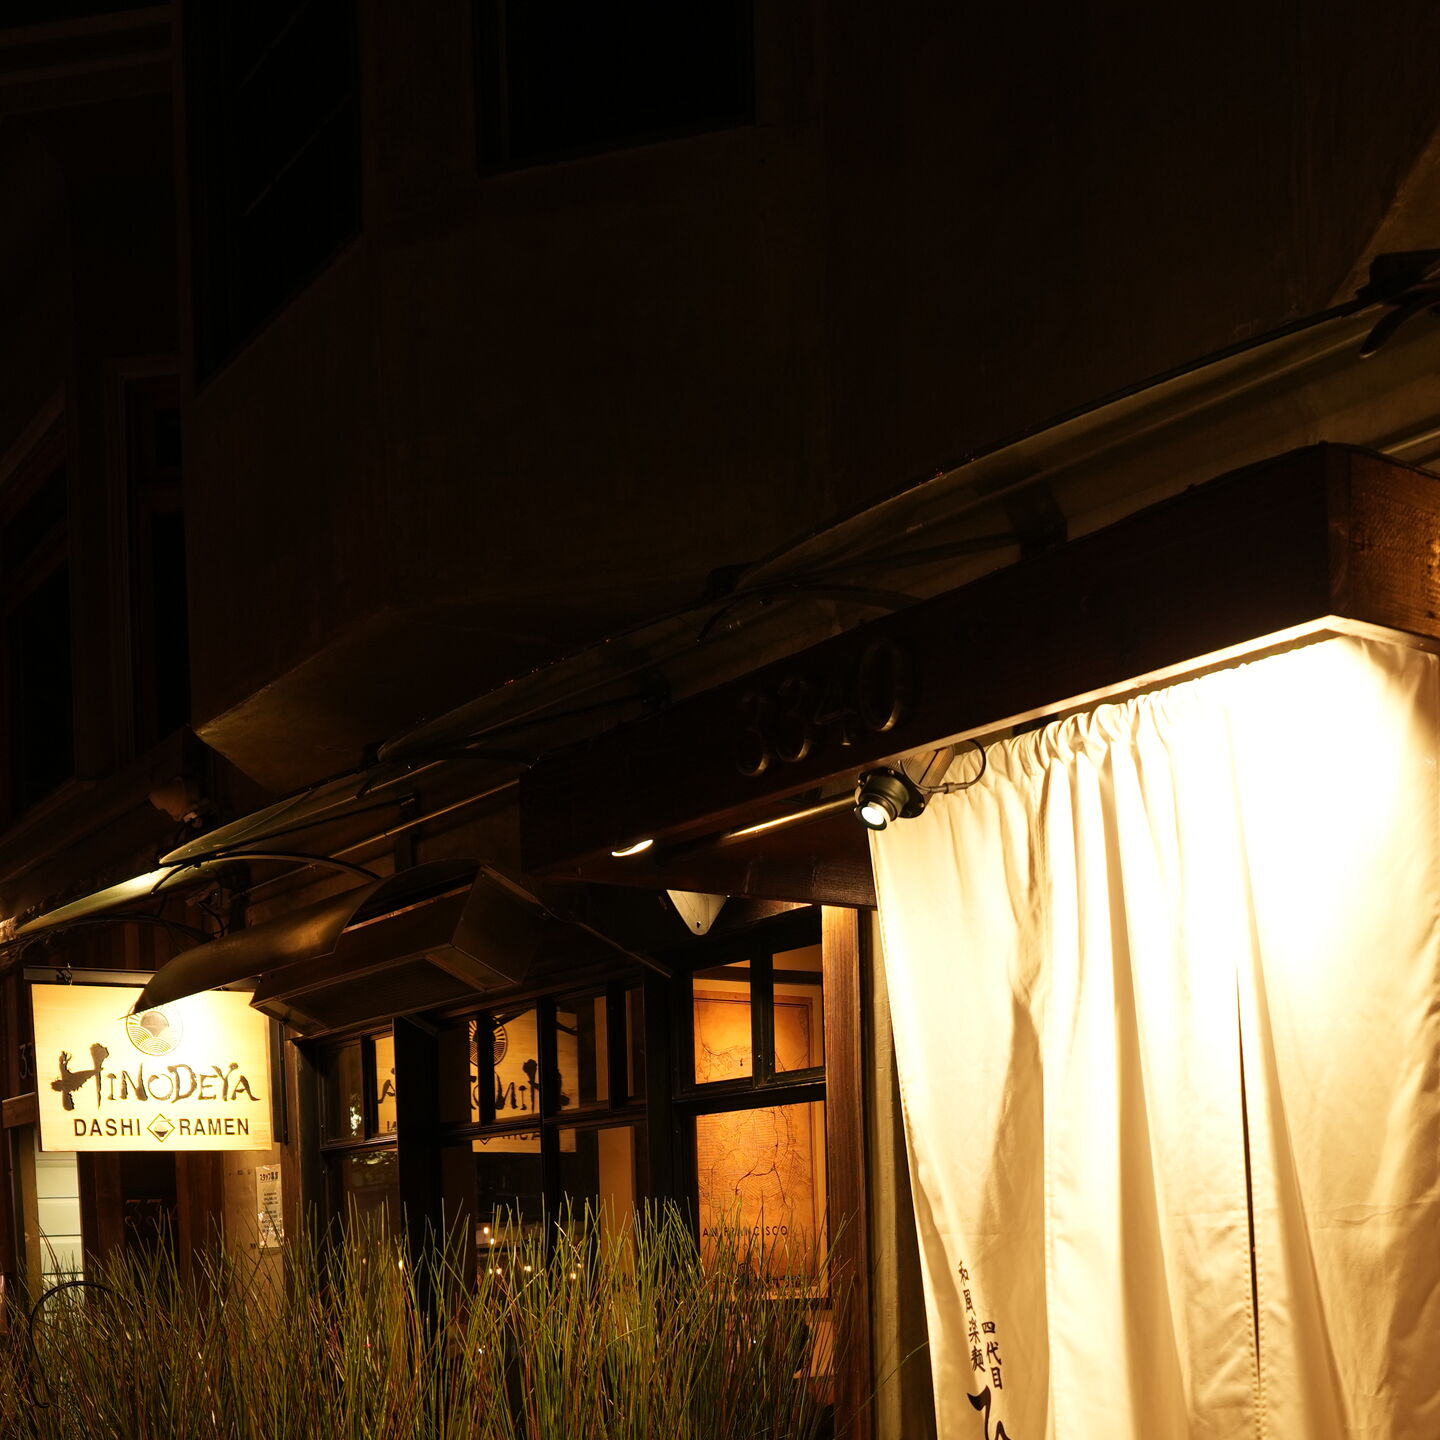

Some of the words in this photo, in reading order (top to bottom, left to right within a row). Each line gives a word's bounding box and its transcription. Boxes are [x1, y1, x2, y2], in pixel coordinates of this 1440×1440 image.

[50, 1043, 261, 1112] HINODEYA
[73, 1117, 141, 1137] DASHI
[179, 1118, 249, 1136] RAMEN
[981, 1321, 1003, 1390] 四代目
